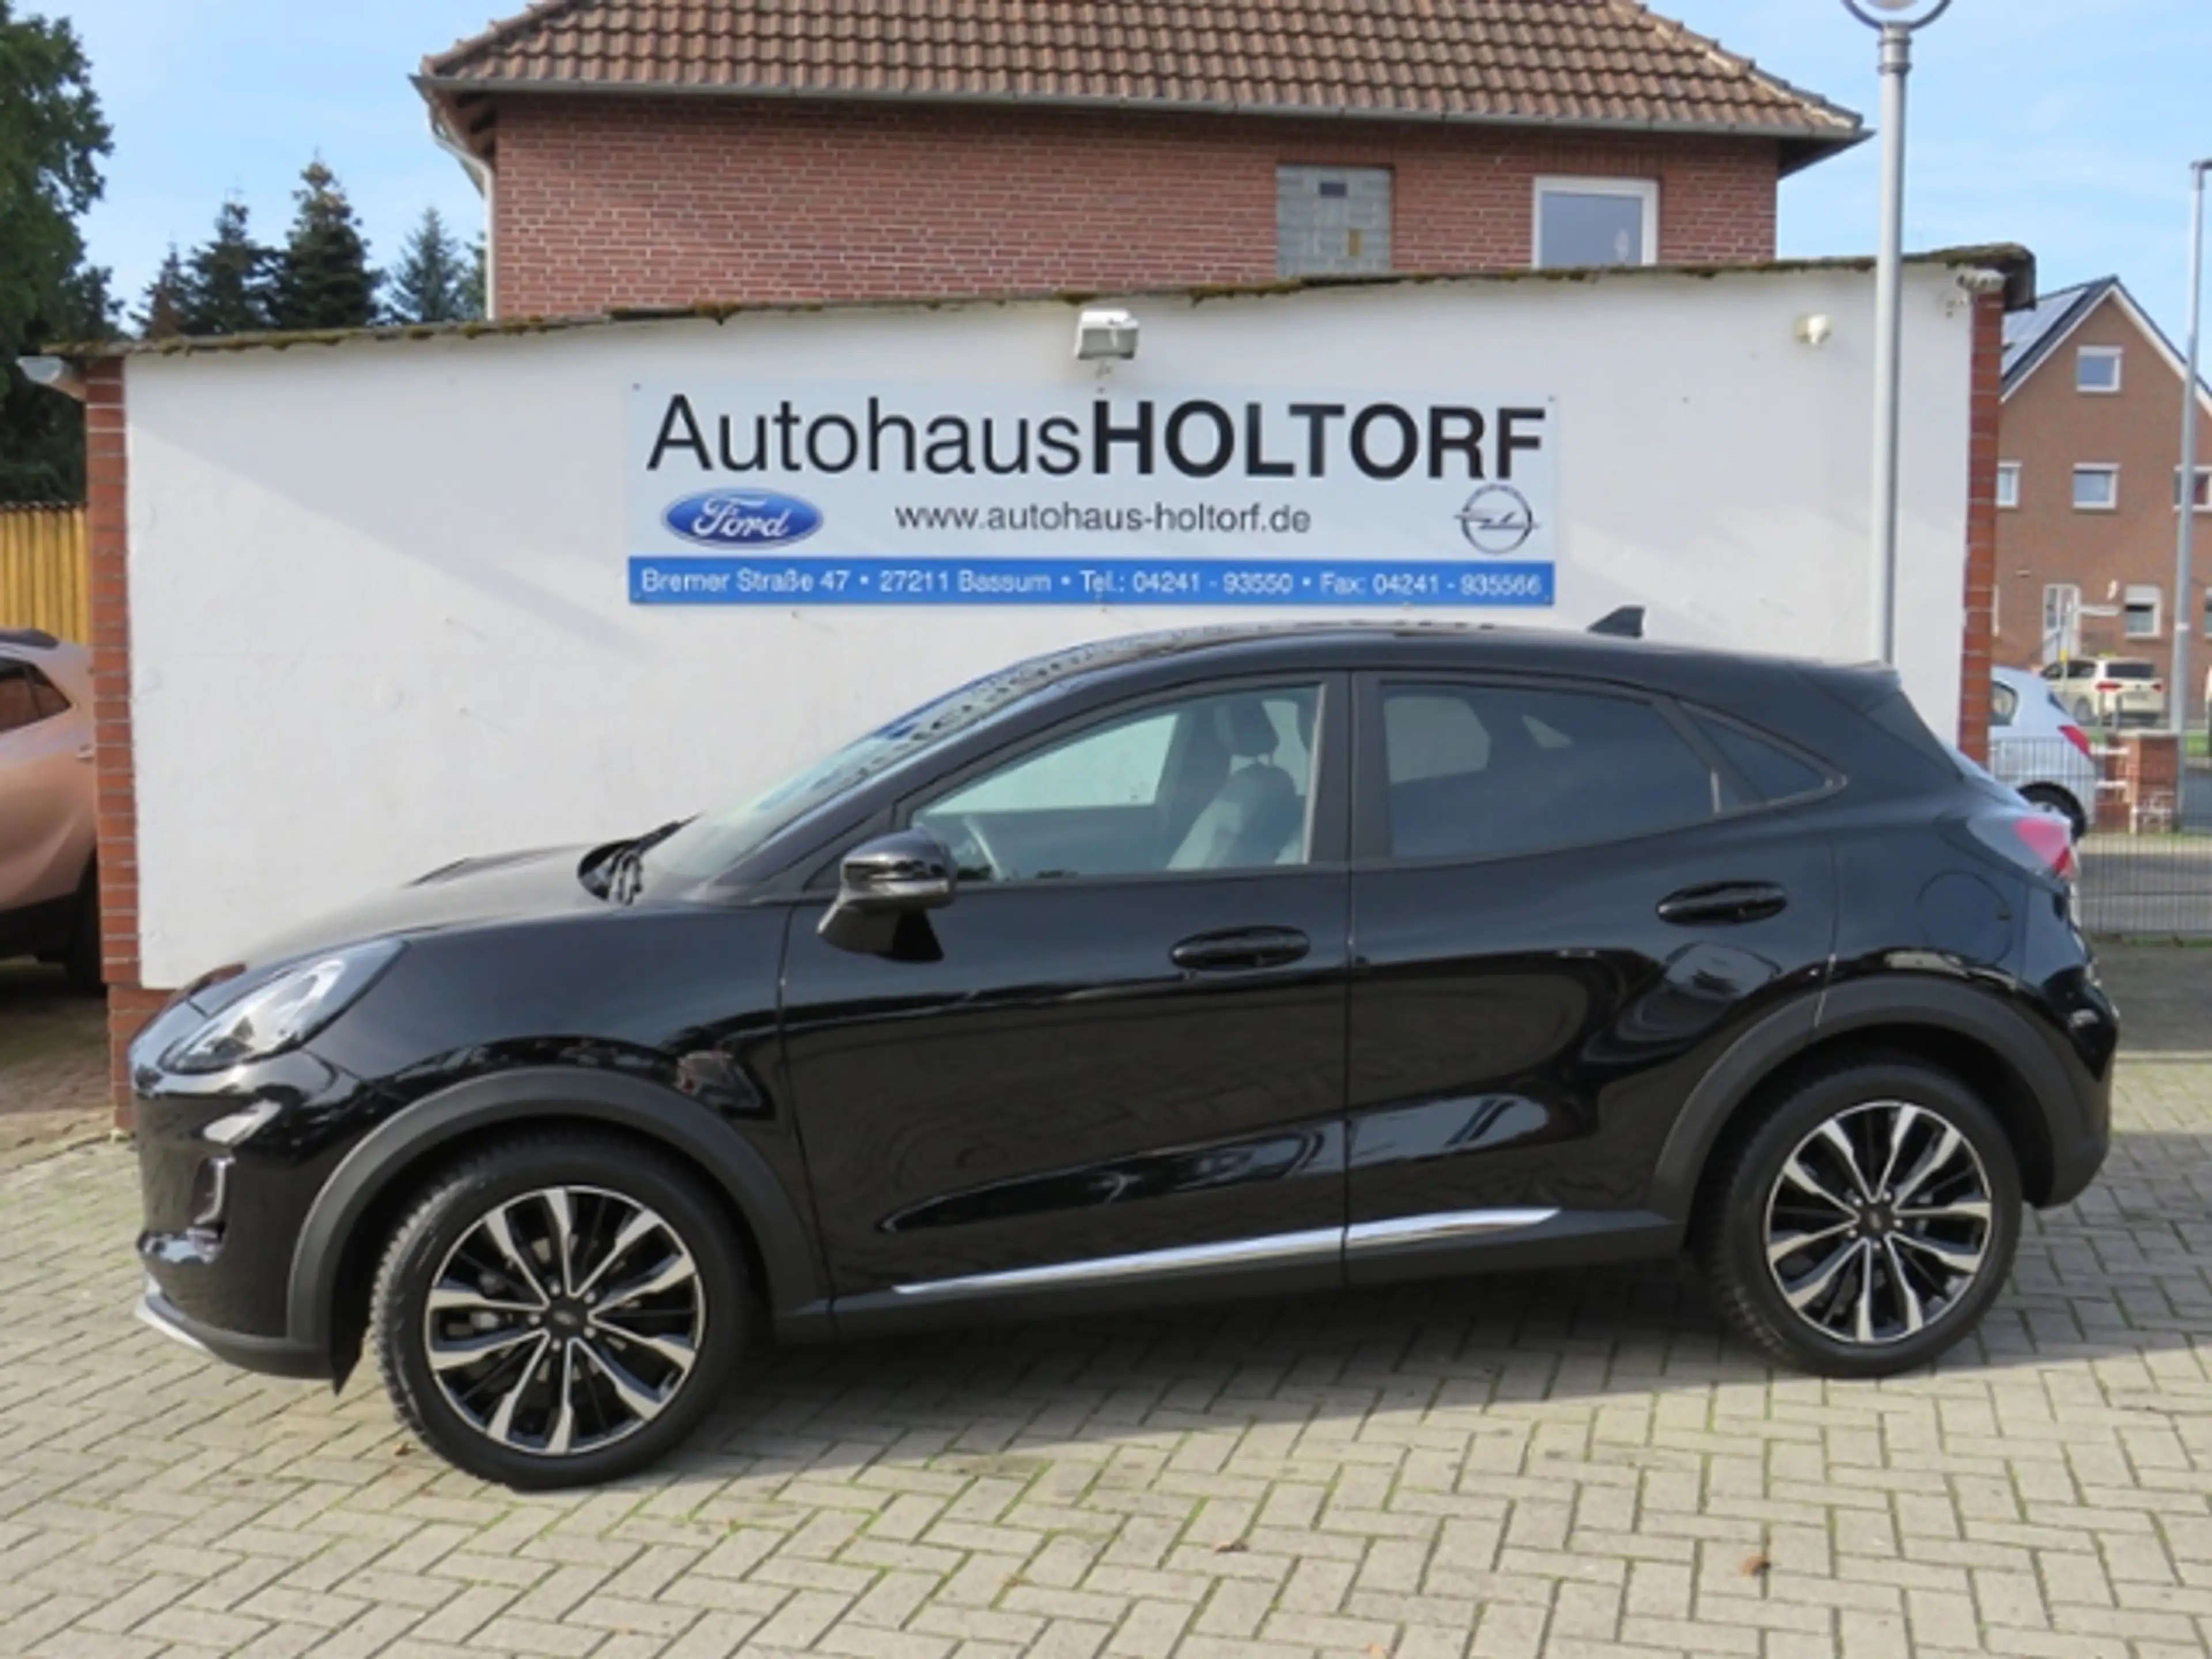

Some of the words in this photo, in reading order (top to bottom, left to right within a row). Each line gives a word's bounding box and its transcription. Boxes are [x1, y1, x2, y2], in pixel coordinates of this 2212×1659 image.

[692, 497, 789, 537] Ford
[895, 502, 1312, 533] www.autohaus-holtorf.de
[641, 567, 730, 592] Bremer
[737, 567, 814, 593] Straße
[819, 569, 851, 592] 47
[880, 569, 949, 593] 27211
[958, 569, 1052, 593] Bassum
[1132, 570, 1199, 593] 04241
[1373, 573, 1439, 596] 04241
